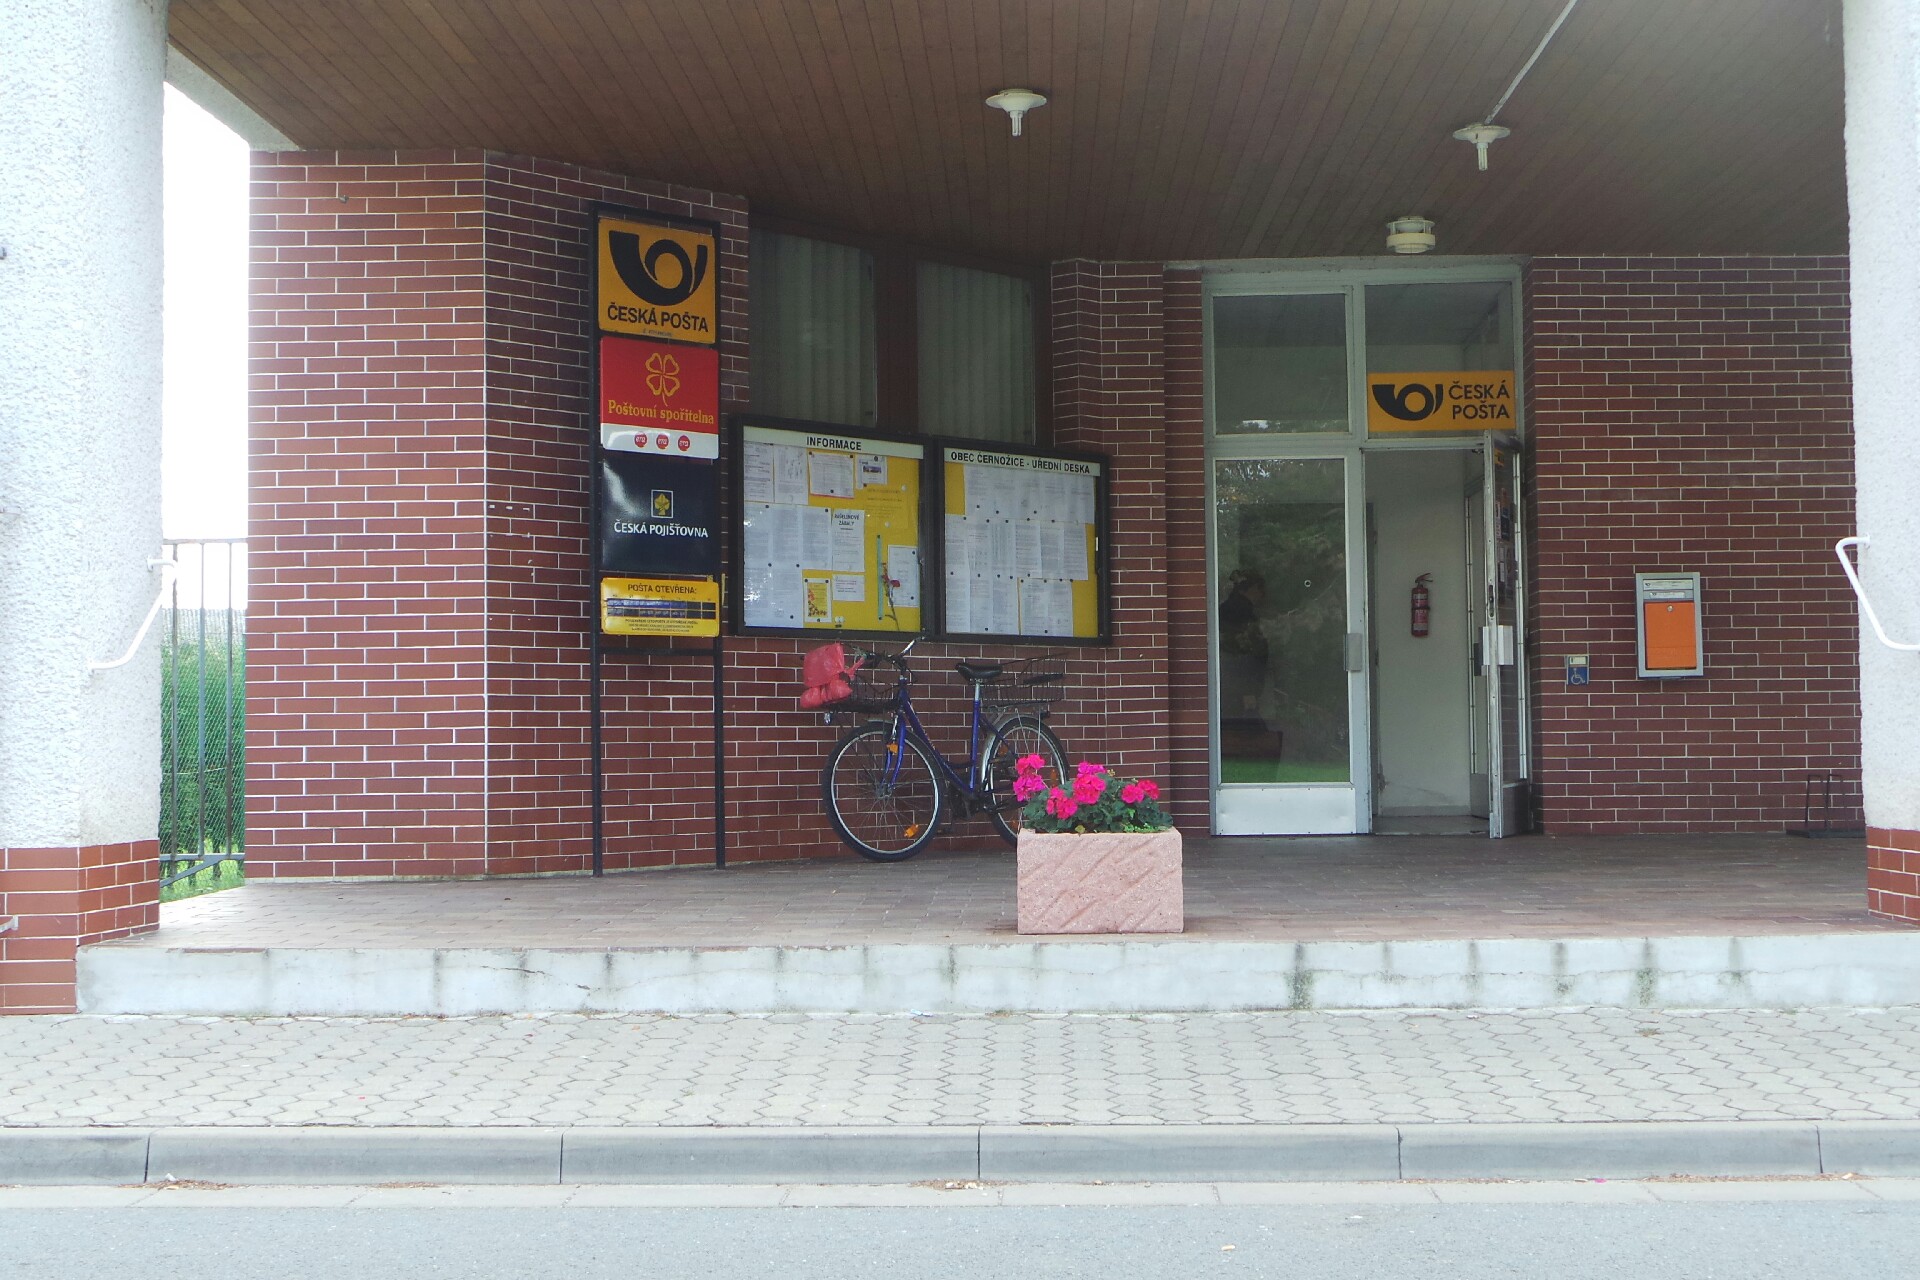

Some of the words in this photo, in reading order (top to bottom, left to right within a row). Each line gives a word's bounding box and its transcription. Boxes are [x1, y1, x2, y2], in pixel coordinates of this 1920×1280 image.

[607, 302, 657, 326] ČESKÁ
[661, 311, 709, 332] POŠTA
[1448, 380, 1510, 400] ČESKÁ
[608, 400, 657, 418] Poštovní
[660, 408, 714, 425] spořitelna
[1452, 401, 1510, 419] POŠTA
[806, 436, 862, 451] INFORMACE
[951, 451, 975, 463] OBEC
[1064, 463, 1090, 474] DESKA
[613, 519, 648, 534] ČESKÁ
[649, 523, 709, 538] POJIŠŤOVNA
[627, 583, 653, 593] POŠTA
[656, 584, 697, 594] OTEVŘENA:
